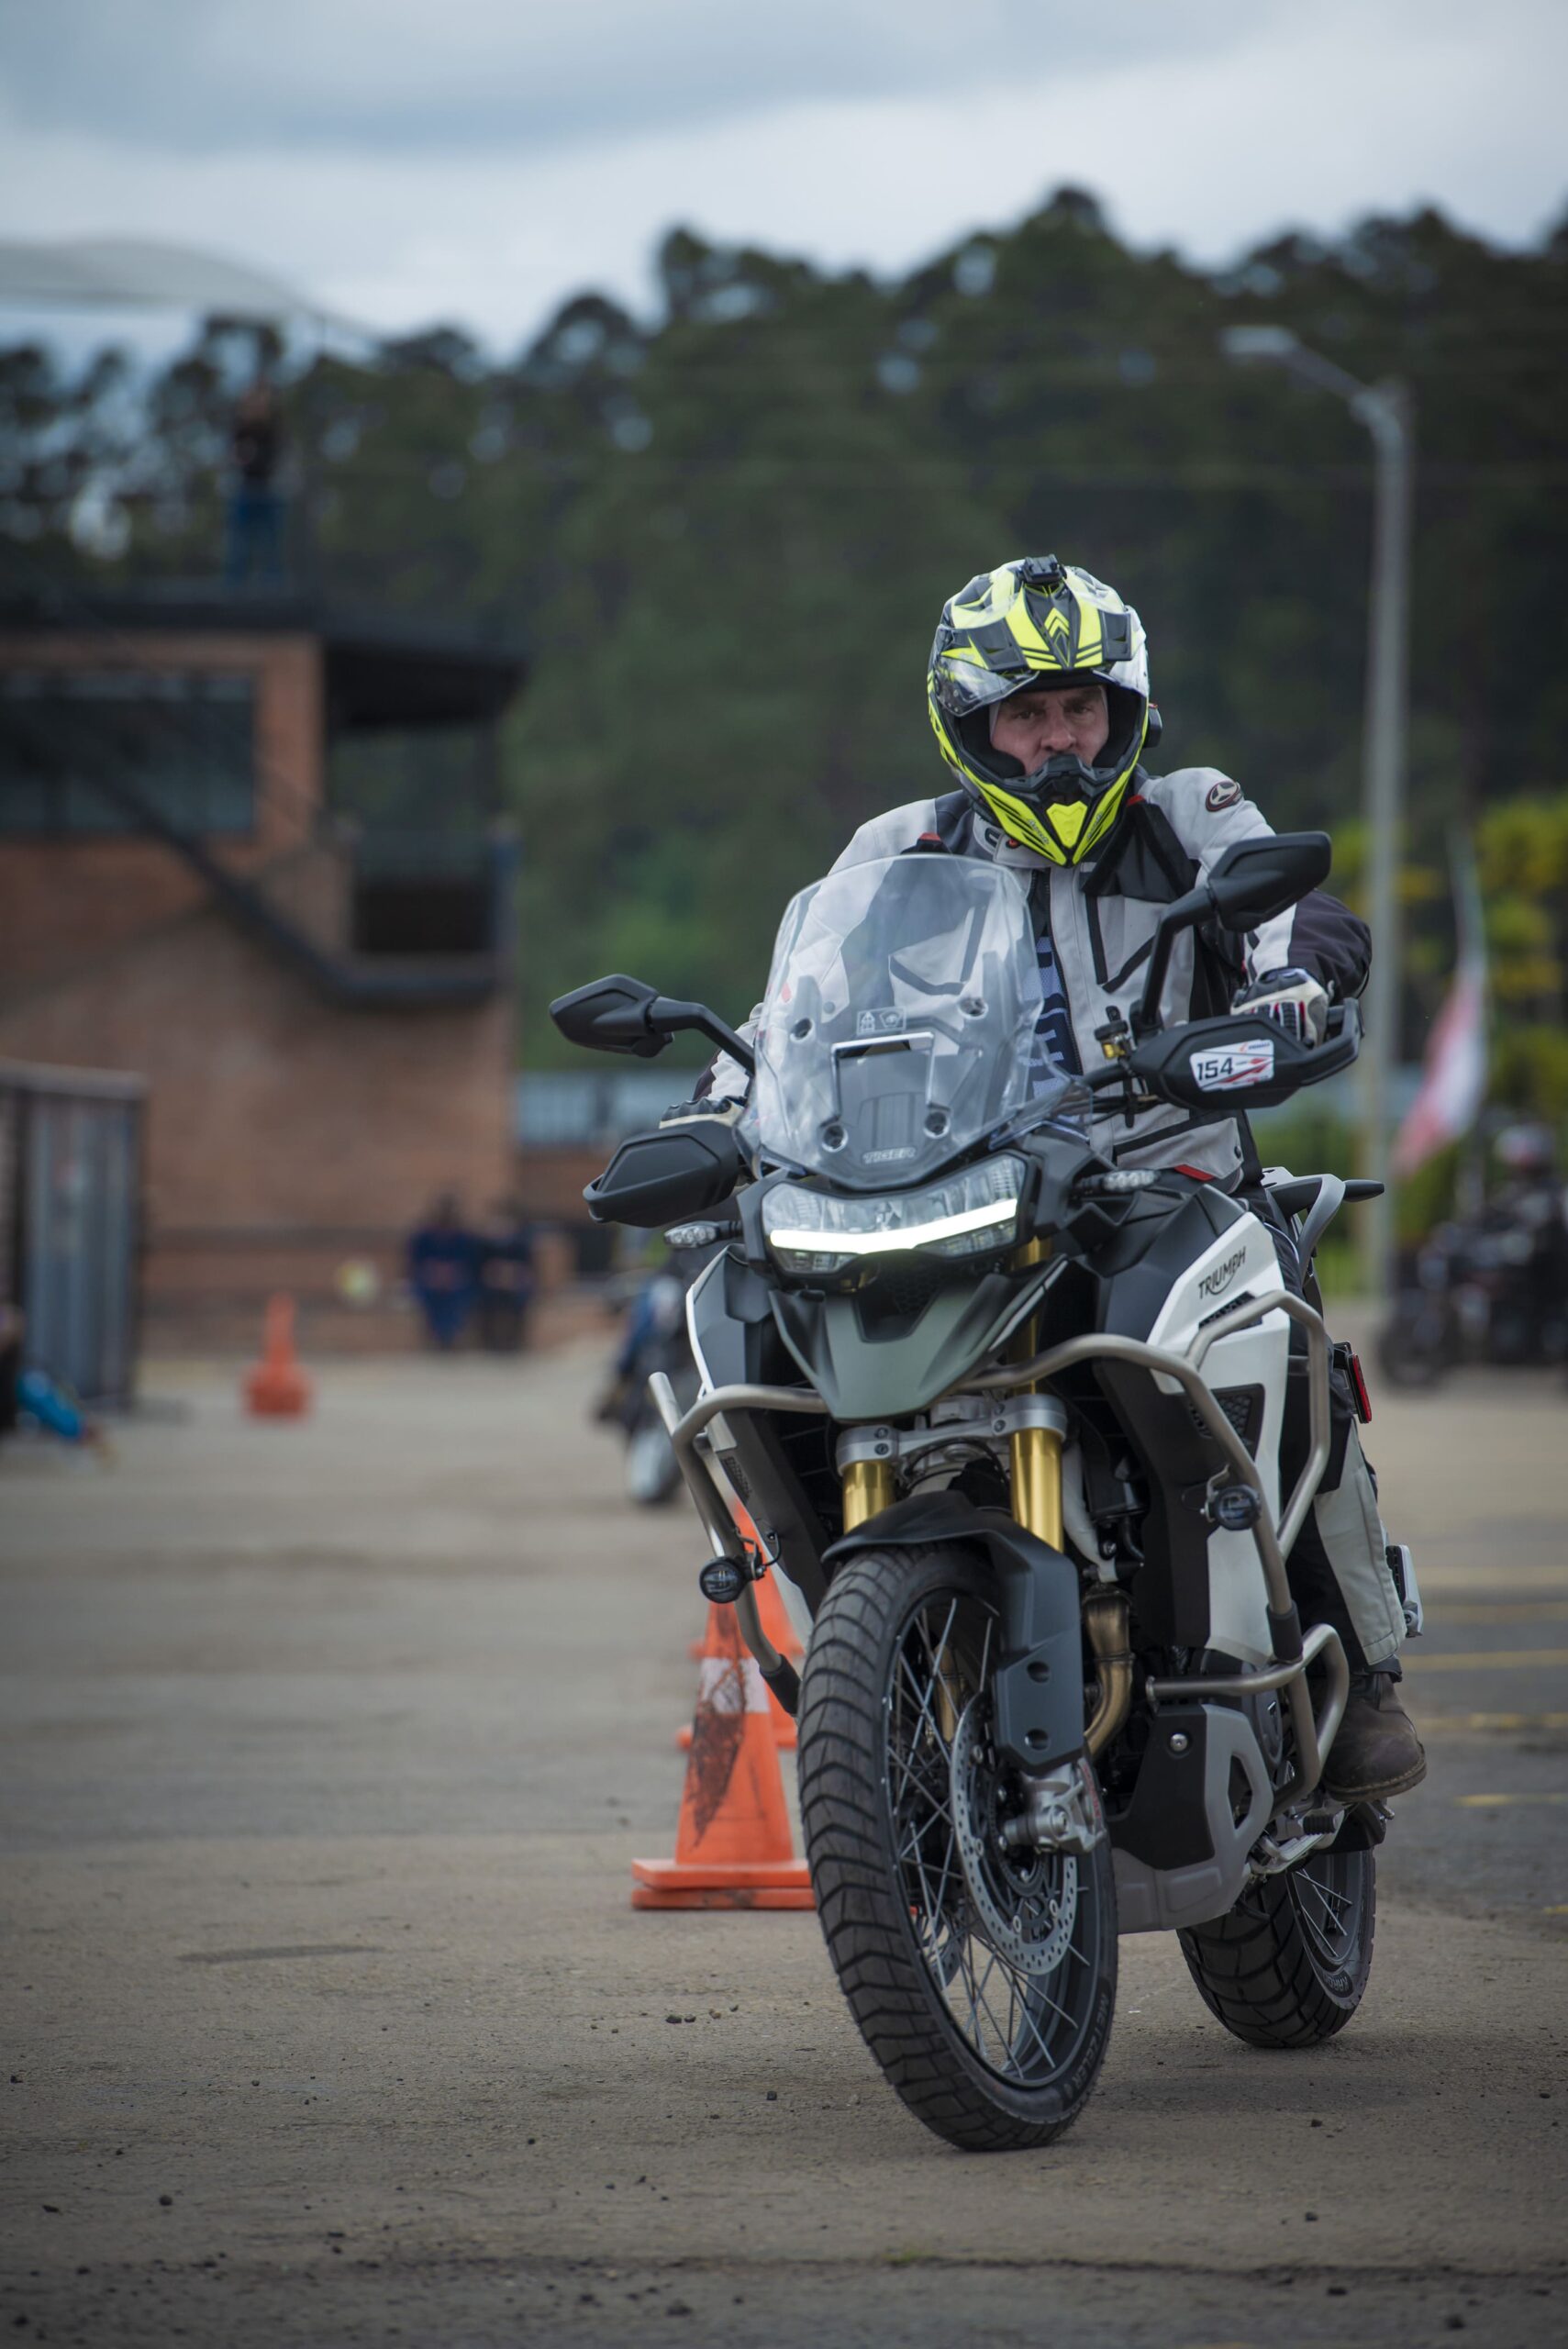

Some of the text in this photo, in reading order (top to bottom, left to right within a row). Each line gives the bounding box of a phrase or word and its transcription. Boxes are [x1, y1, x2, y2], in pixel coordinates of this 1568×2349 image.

[1197, 1057, 1233, 1081] 154
[1198, 1246, 1246, 1299] TRIUMPH
[1071, 1992, 1110, 2089] METZELER
